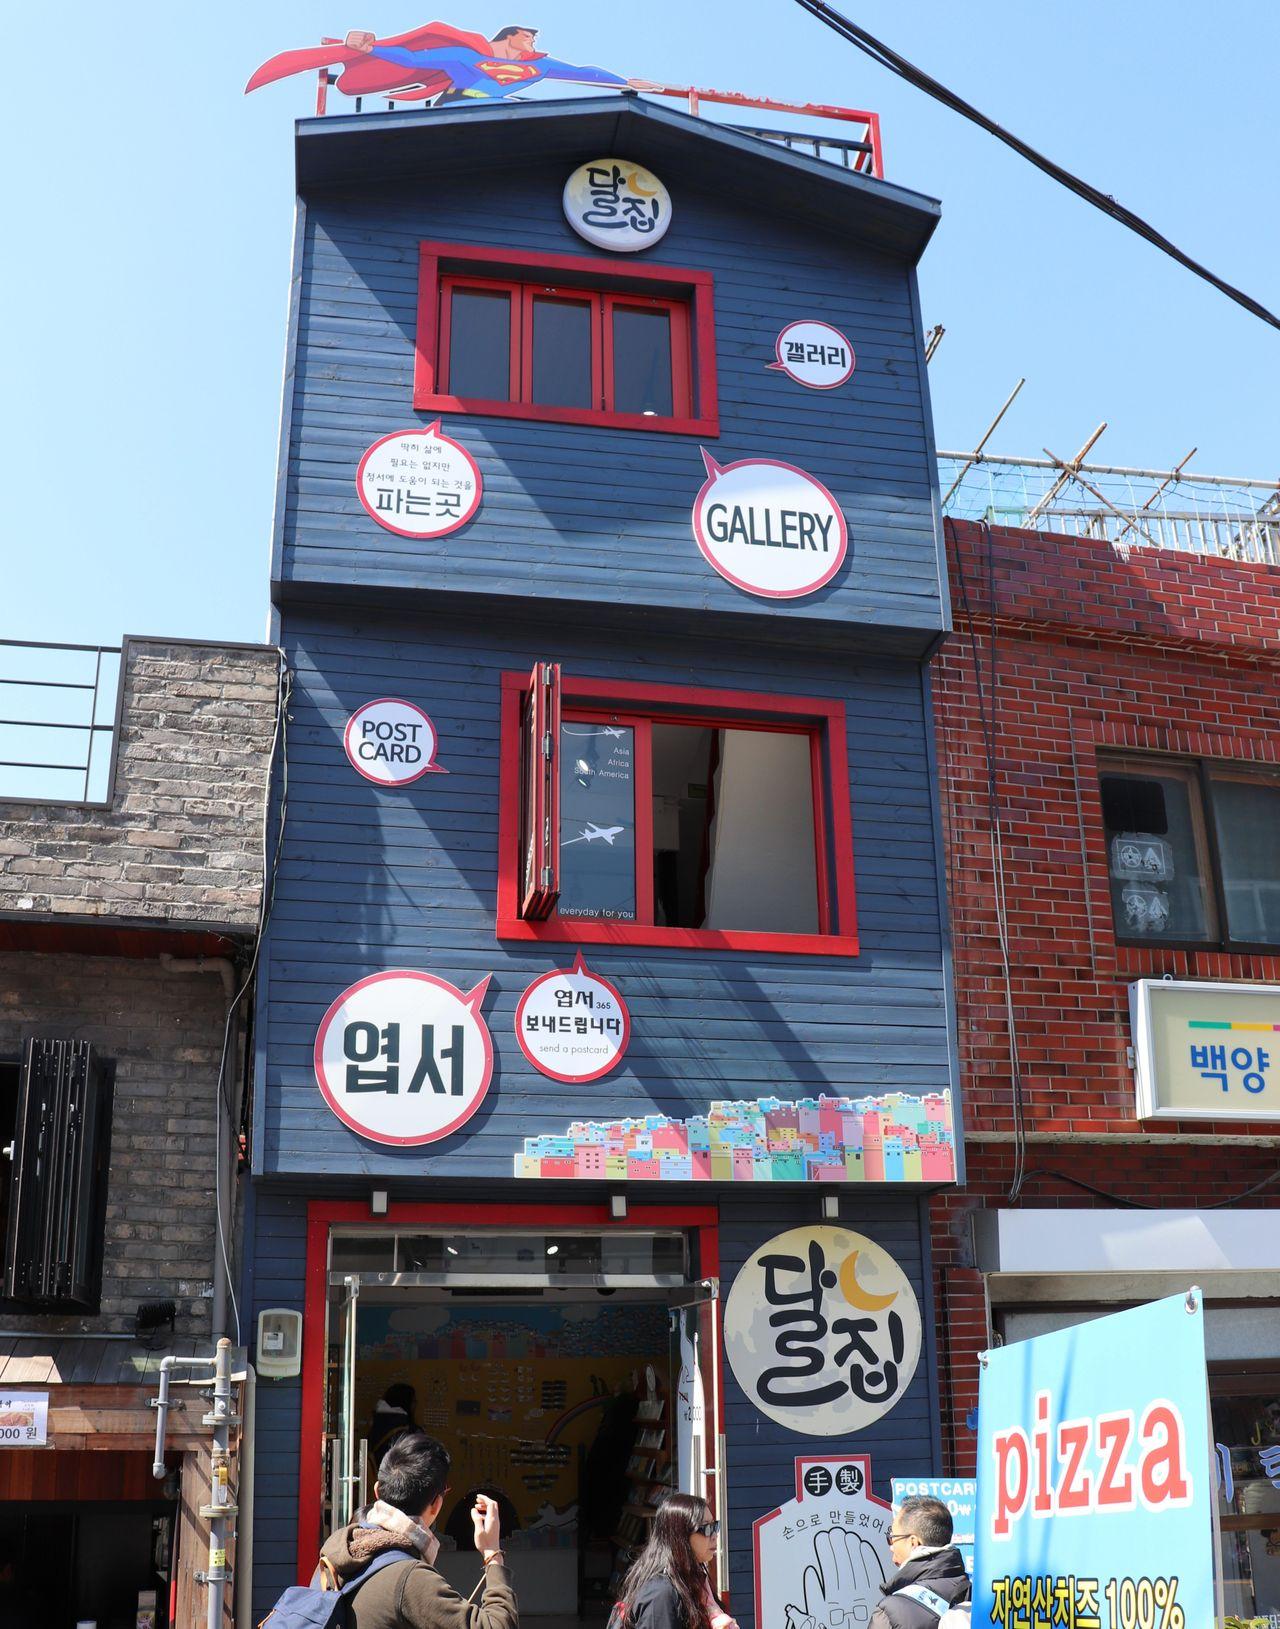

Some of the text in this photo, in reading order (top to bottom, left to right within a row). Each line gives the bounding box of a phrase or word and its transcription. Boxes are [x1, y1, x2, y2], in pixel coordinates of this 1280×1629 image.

[582, 165, 659, 234] 달집
[784, 340, 847, 368] 갤러리
[400, 442, 419, 452] 딱히
[390, 458, 450, 472] 필요는 없지만
[366, 472, 472, 490] 정서에 도움이 되는 것을
[376, 488, 461, 518] 파는곳
[706, 502, 834, 552] GALLERY
[361, 719, 422, 743] POST
[358, 742, 422, 764] CARD
[613, 747, 630, 756] Asia
[607, 759, 630, 767] Africa
[598, 769, 630, 780] America
[559, 907, 634, 919] everyday for you
[554, 989, 594, 1009] 엽서
[526, 1015, 621, 1036] 보내드립니다
[342, 1020, 465, 1096] 엽서
[539, 1044, 560, 1053] send
[571, 1045, 609, 1056] postcard
[1190, 1045, 1270, 1094] 백양
[755, 1239, 905, 1407] 달집
[26, 1427, 37, 1440] 원
[991, 1393, 1190, 1538] pizza
[807, 1468, 860, 1494] 手製
[895, 1482, 977, 1496] POSTCAR
[783, 1513, 822, 1540] 손으로
[990, 1575, 1185, 1629] 자연산치즈 100%
